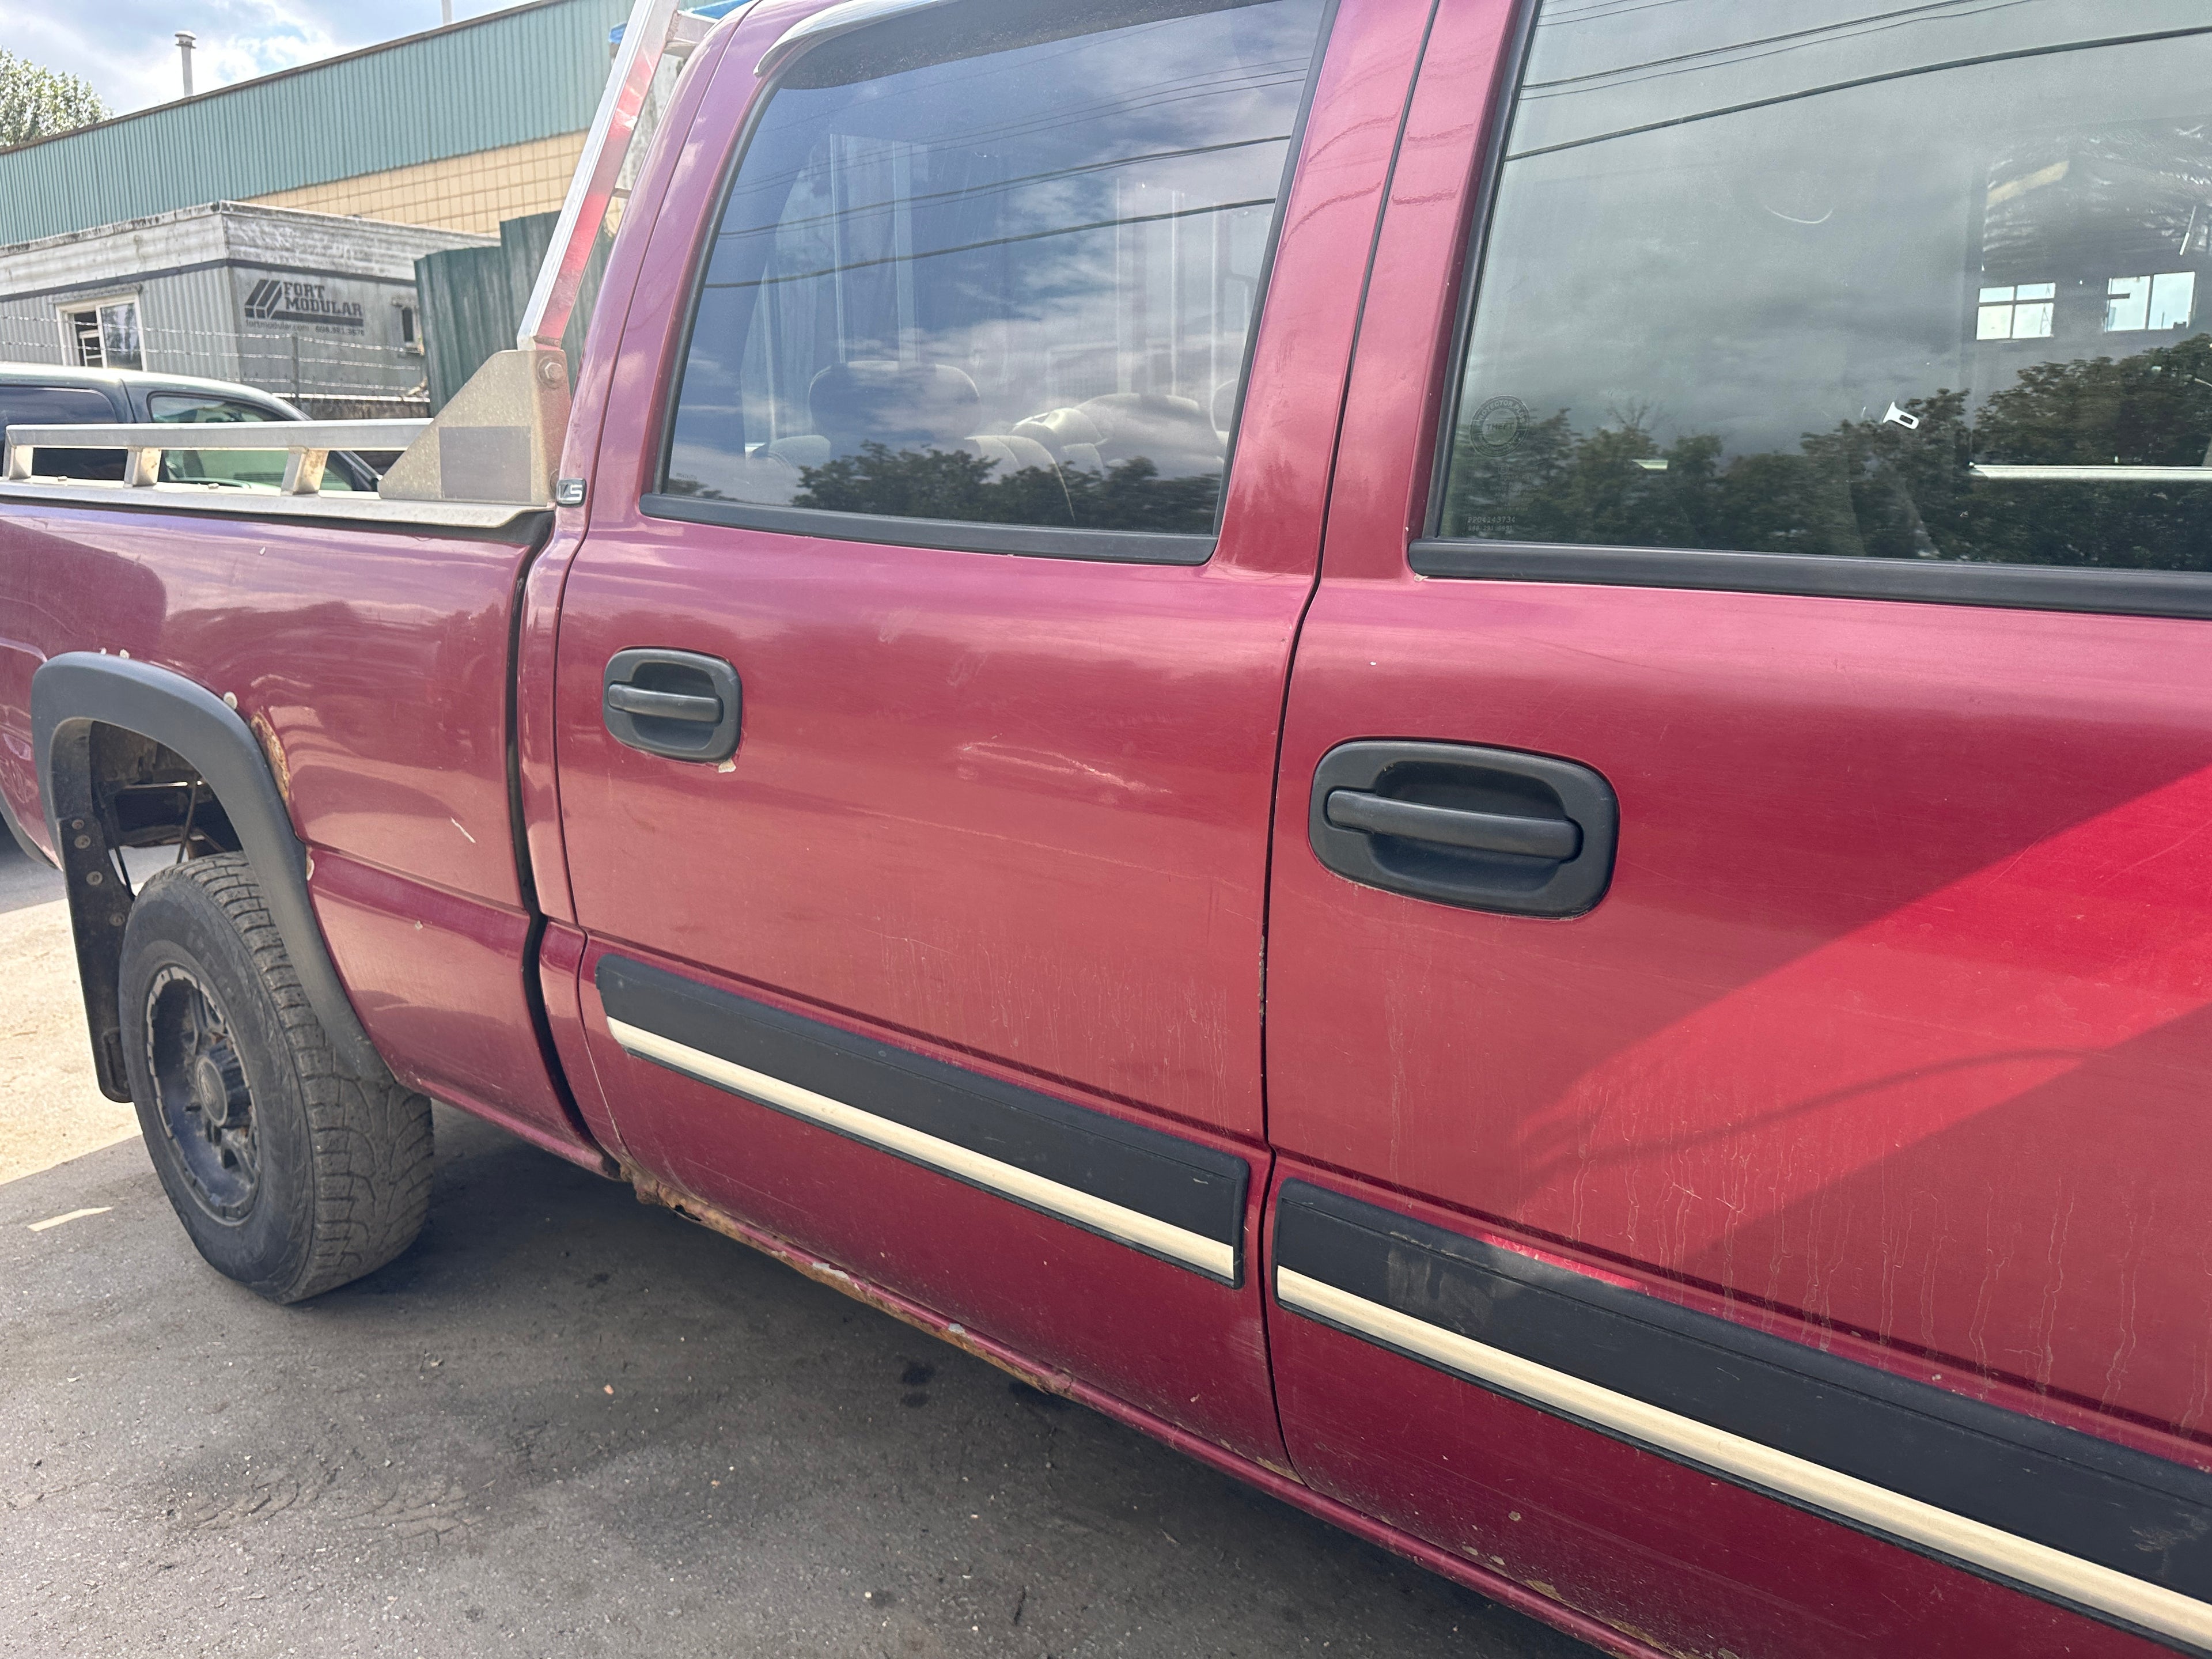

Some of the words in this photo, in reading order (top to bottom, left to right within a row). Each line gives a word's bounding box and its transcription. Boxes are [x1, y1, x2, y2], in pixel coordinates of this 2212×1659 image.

[283, 282, 325, 298] FORT
[286, 297, 362, 316] MODULAR
[1486, 422, 1514, 430] THEFT
